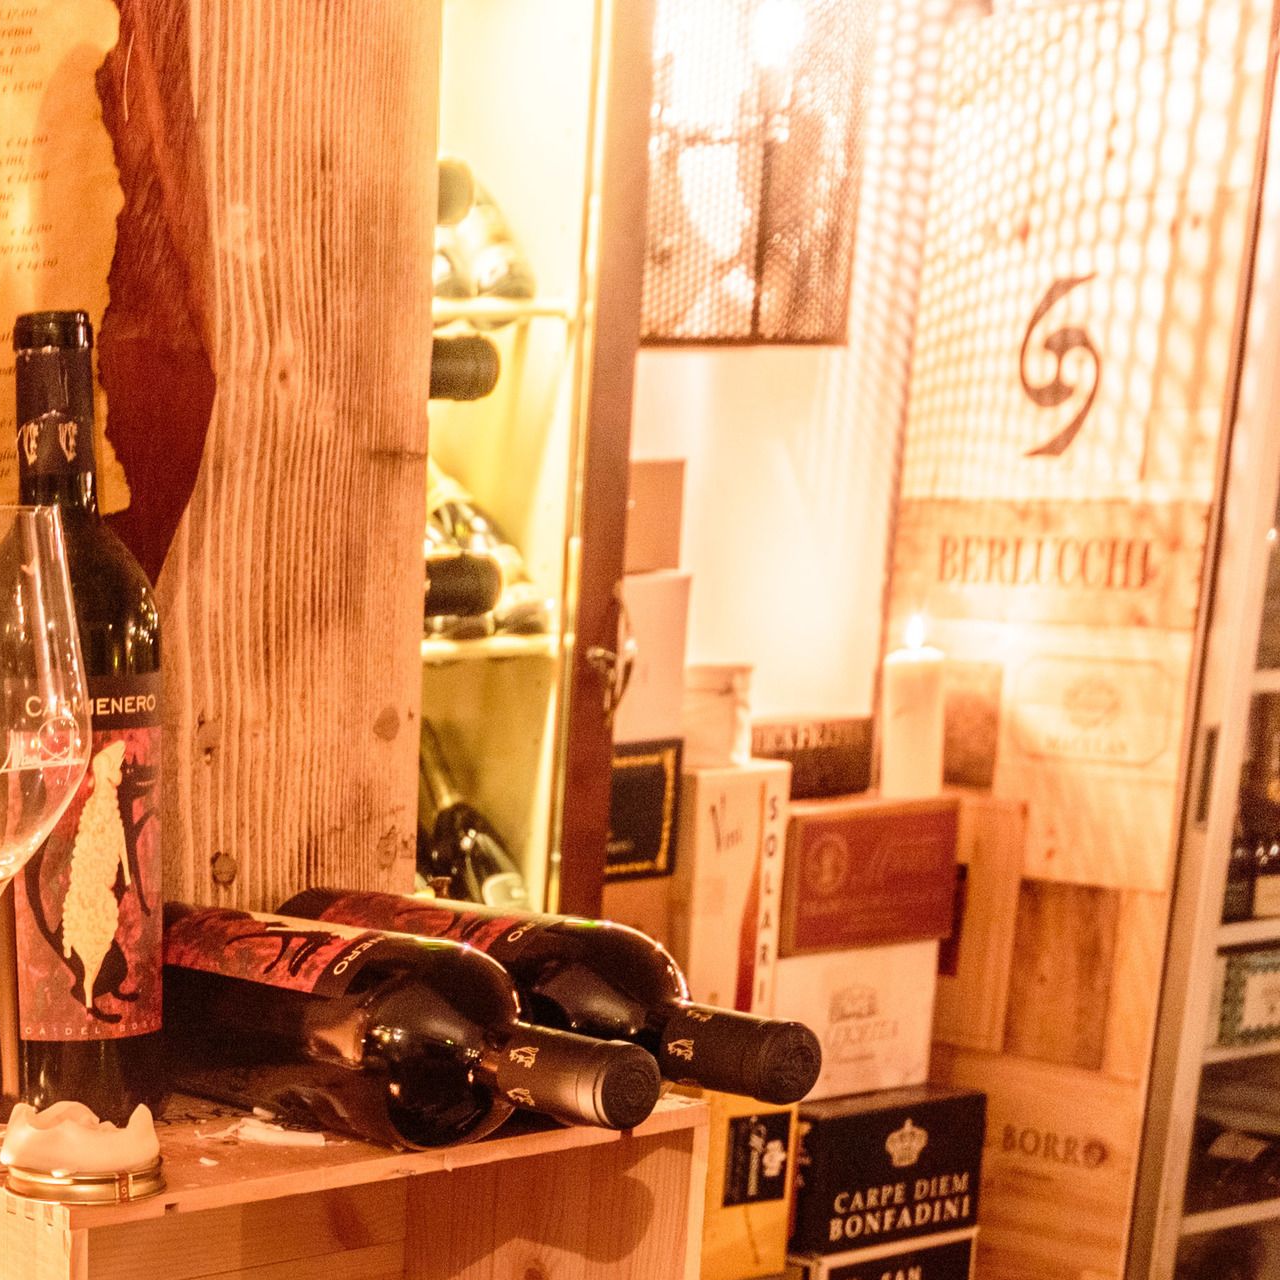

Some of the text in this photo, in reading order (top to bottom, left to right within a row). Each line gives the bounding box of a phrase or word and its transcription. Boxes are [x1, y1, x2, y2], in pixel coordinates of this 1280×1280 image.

[937, 534, 1158, 589] BERLUCCHI
[64, 1026, 102, 1036] DEL
[833, 1171, 971, 1215] CARPE DIEM
[828, 1196, 971, 1242] BONFADINI
